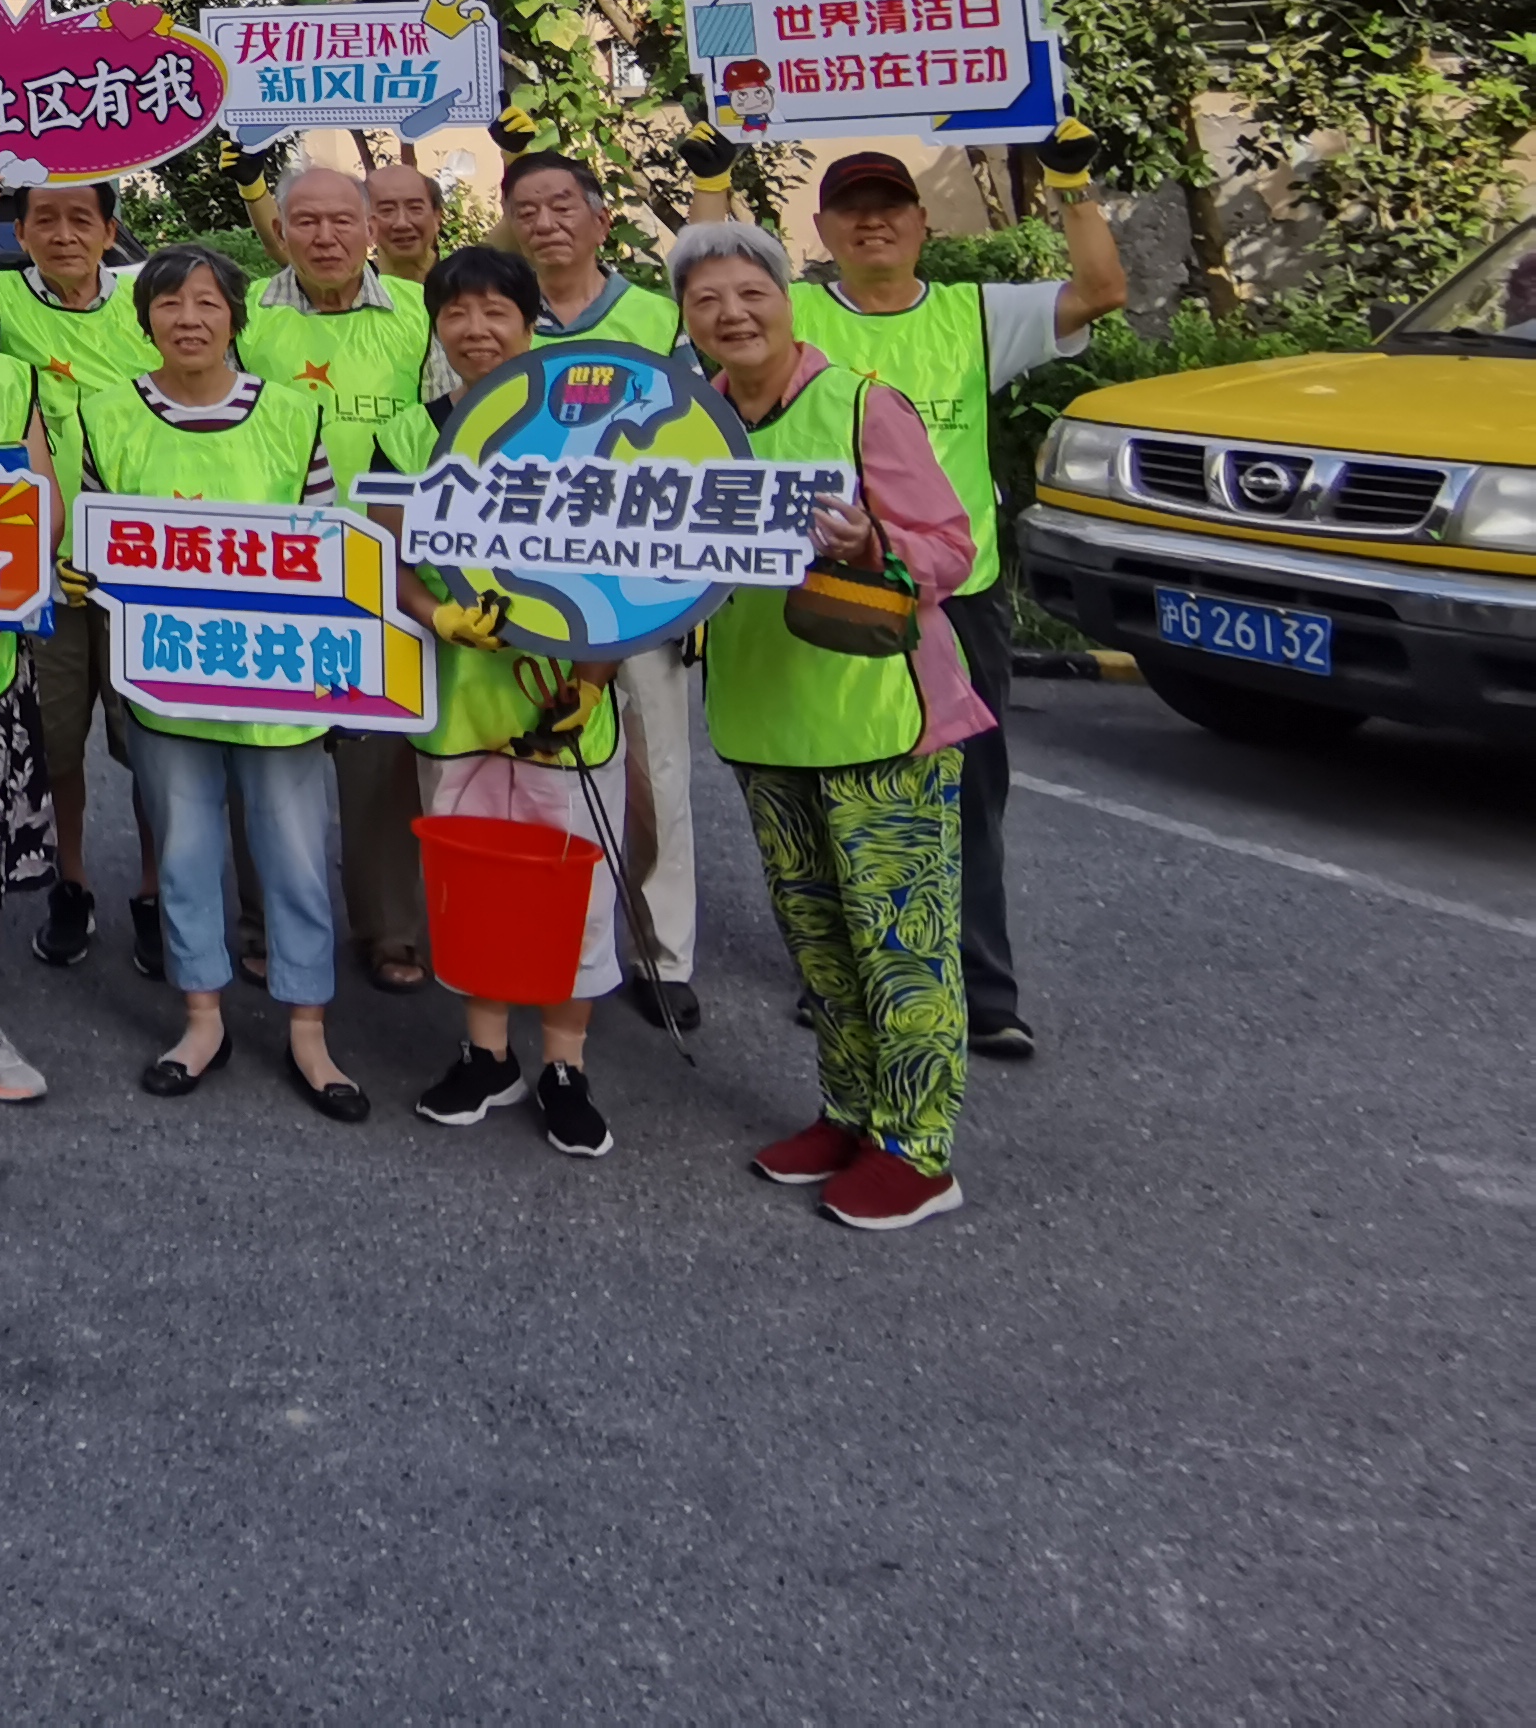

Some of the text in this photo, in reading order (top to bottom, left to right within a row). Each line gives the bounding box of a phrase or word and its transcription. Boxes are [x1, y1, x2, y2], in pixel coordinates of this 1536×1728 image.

[234, 20, 432, 63] 我们是环保
[257, 60, 440, 104] 新风尚
[778, 46, 1008, 94] 临汾在行动
[335, 393, 405, 420] LFCF
[356, 460, 844, 537] 一个洁净的星球
[107, 519, 323, 583] 品质社区
[410, 530, 803, 576] FOR A CLEAN PLANET
[142, 612, 362, 688] 你我共创
[1159, 596, 1326, 666] 沪G26132
